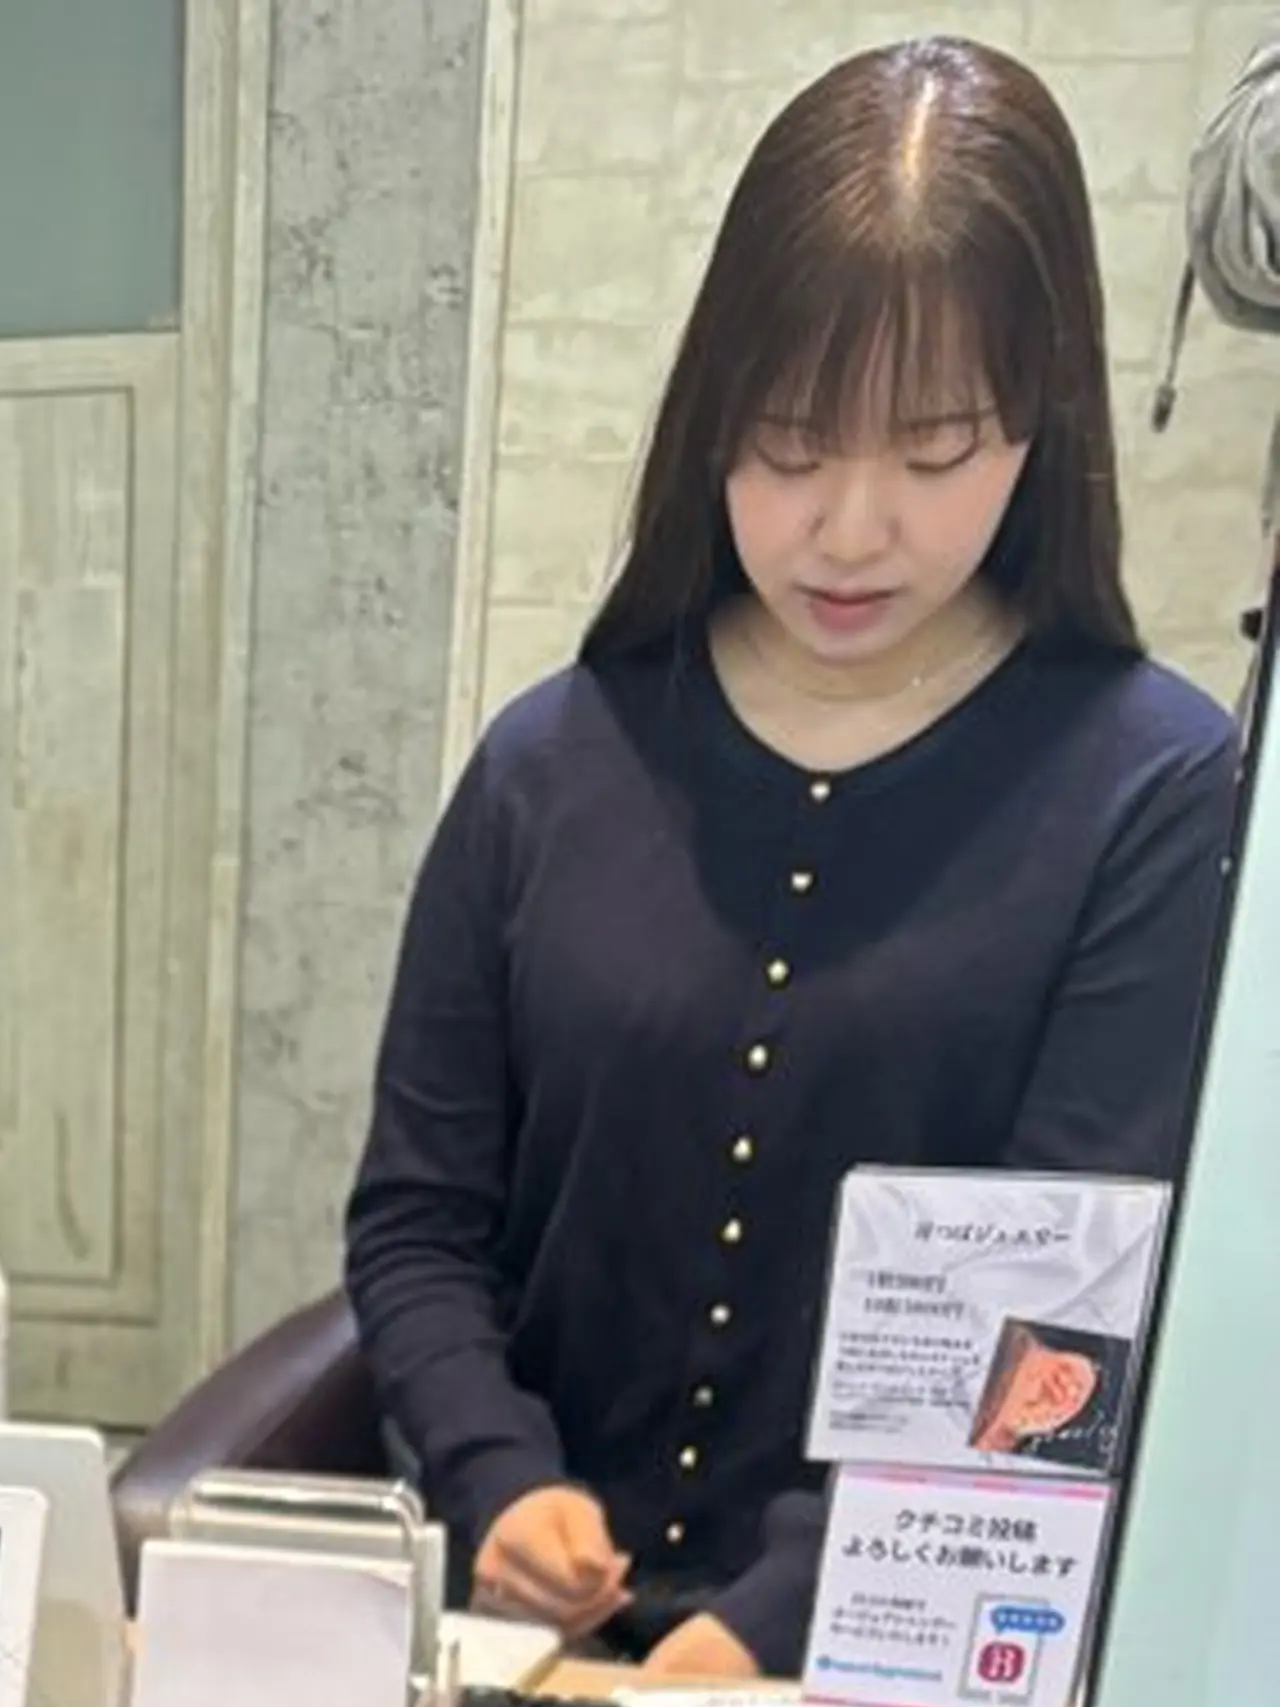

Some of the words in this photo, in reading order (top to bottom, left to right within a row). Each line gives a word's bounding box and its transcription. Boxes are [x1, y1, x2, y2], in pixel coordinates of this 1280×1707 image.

[842, 1533, 1078, 1577] よろしくお願いします
